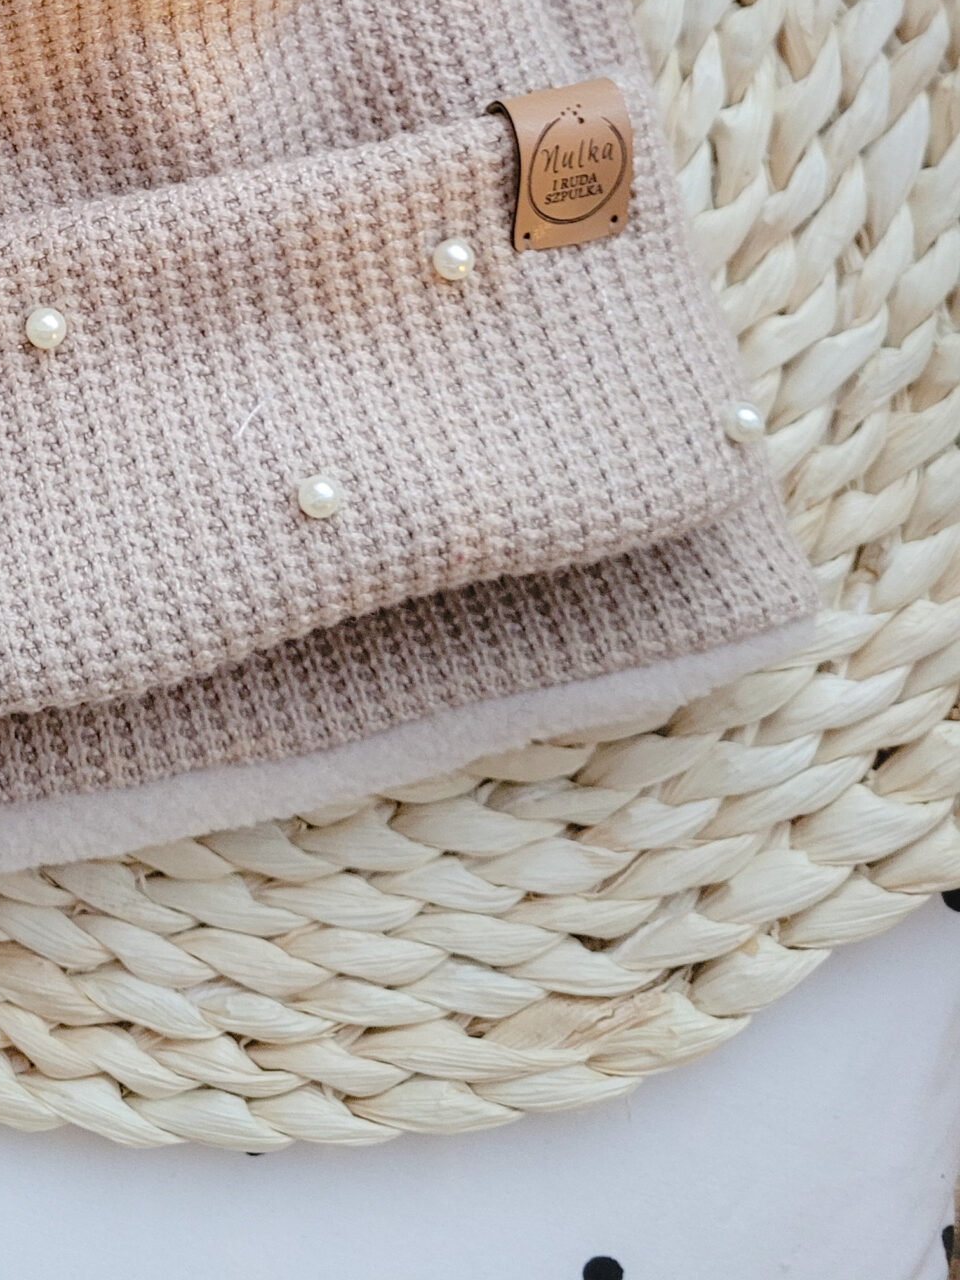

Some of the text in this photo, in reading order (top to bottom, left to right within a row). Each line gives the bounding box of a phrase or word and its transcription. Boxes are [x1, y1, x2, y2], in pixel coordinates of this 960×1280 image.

[542, 138, 614, 173] Nulka
[552, 173, 597, 191] I RUDA
[544, 184, 603, 205] SZPULKA
